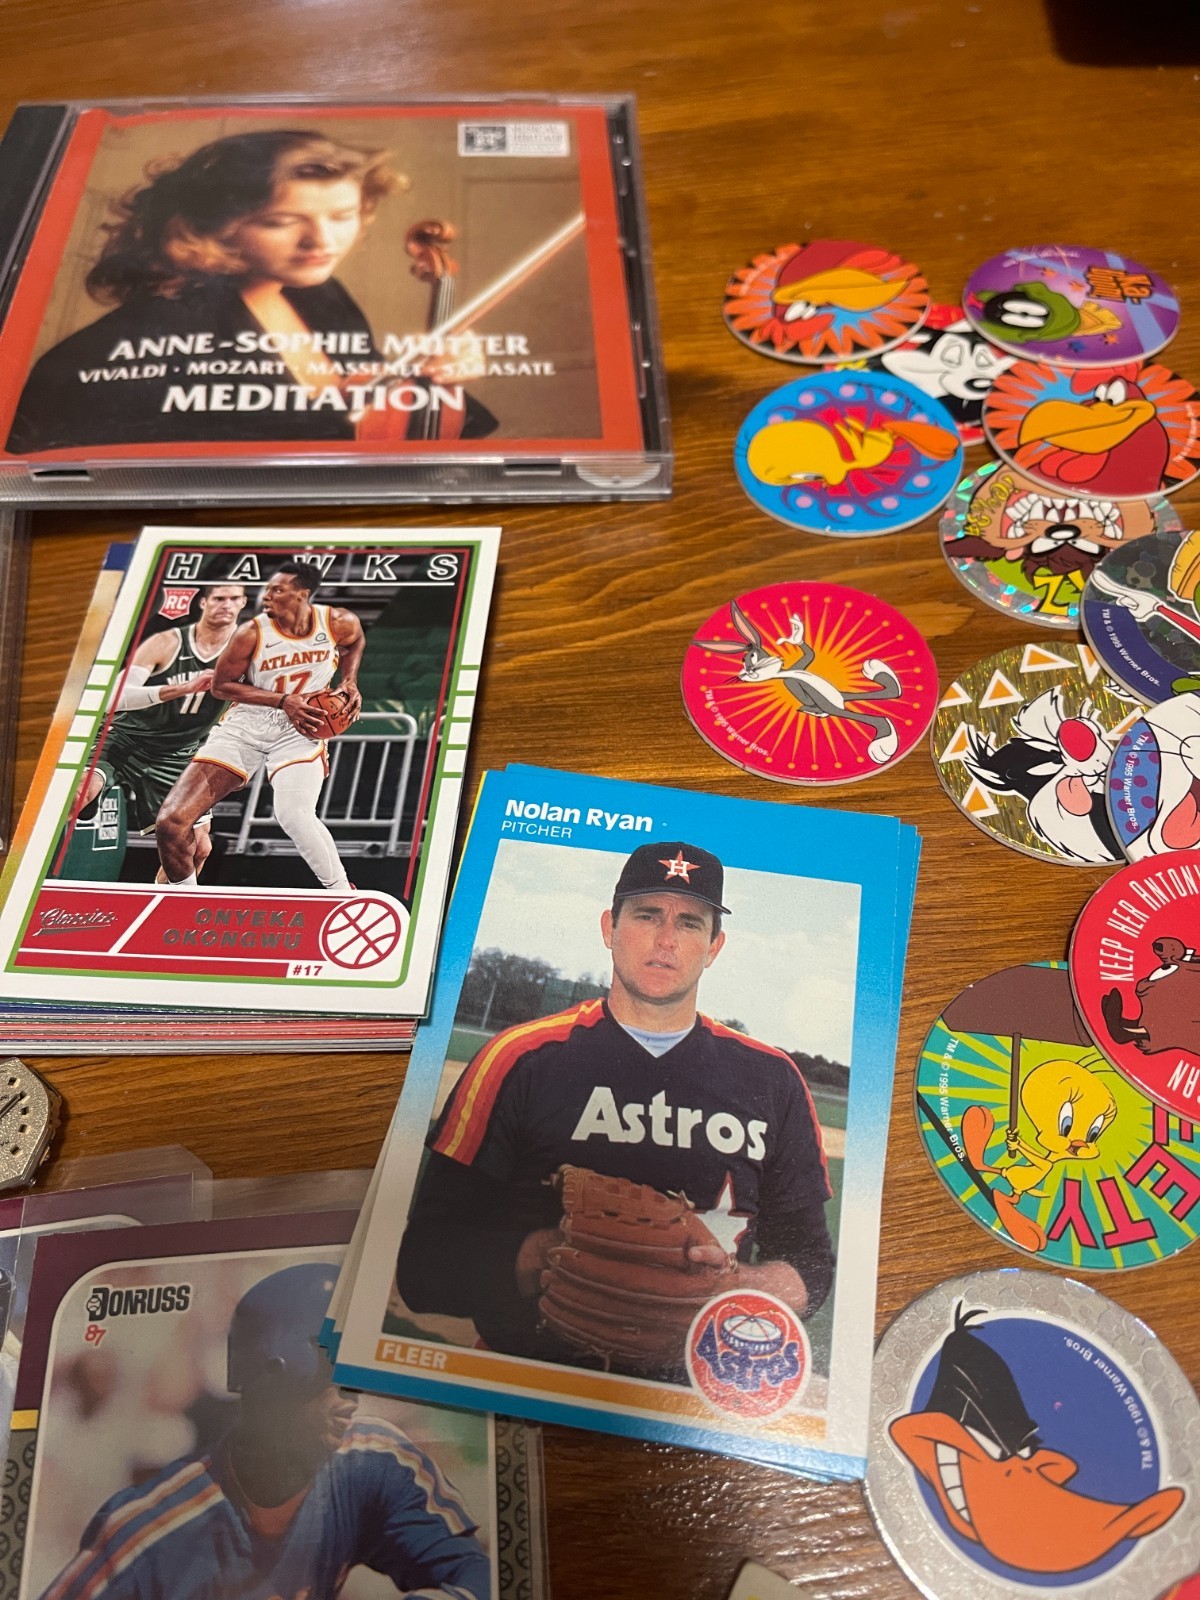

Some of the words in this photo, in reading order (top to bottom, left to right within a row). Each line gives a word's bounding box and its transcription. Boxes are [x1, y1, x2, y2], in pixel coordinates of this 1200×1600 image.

[107, 331, 371, 361] ANNE-SOPHIE
[383, 333, 531, 356] MUTTER
[78, 364, 167, 383] VIVALDI
[186, 360, 285, 375] MOZART
[161, 383, 464, 412] MEDITATION
[165, 595, 190, 610] RC
[1102, 608, 1111, 619] TM
[1108, 632, 1123, 648] 1995
[1119, 648, 1142, 671] Warner
[1140, 669, 1160, 687] Bros.
[271, 671, 314, 695] 17
[726, 725, 750, 746] Warner
[749, 742, 769, 756] Bros.
[1136, 734, 1149, 747] TM
[1124, 759, 1135, 777] 1995
[1123, 777, 1132, 806] Warner
[501, 820, 573, 839] PITCHER
[505, 799, 580, 824] Nolan
[586, 808, 653, 832] Ryan
[667, 860, 690, 877] H
[195, 908, 305, 928] ONYEKA
[1106, 900, 1150, 938] HER
[163, 929, 302, 950] OKONGWU
[292, 964, 323, 977] #17
[1099, 937, 1134, 981] KEEP
[945, 1038, 959, 1053] TM
[939, 1072, 949, 1095] 1995
[1166, 1059, 1200, 1103] AN
[571, 1086, 768, 1161] Astros
[940, 1096, 953, 1132] Warner
[949, 1133, 966, 1161] Bros.
[86, 1285, 191, 1321] DONRUSS
[84, 1324, 107, 1346] 87
[1063, 1336, 1094, 1361] Bros.
[382, 1342, 448, 1370] FLEER
[1093, 1358, 1127, 1396] Warner
[1123, 1396, 1144, 1425] 1995
[1141, 1449, 1153, 1470] TM
